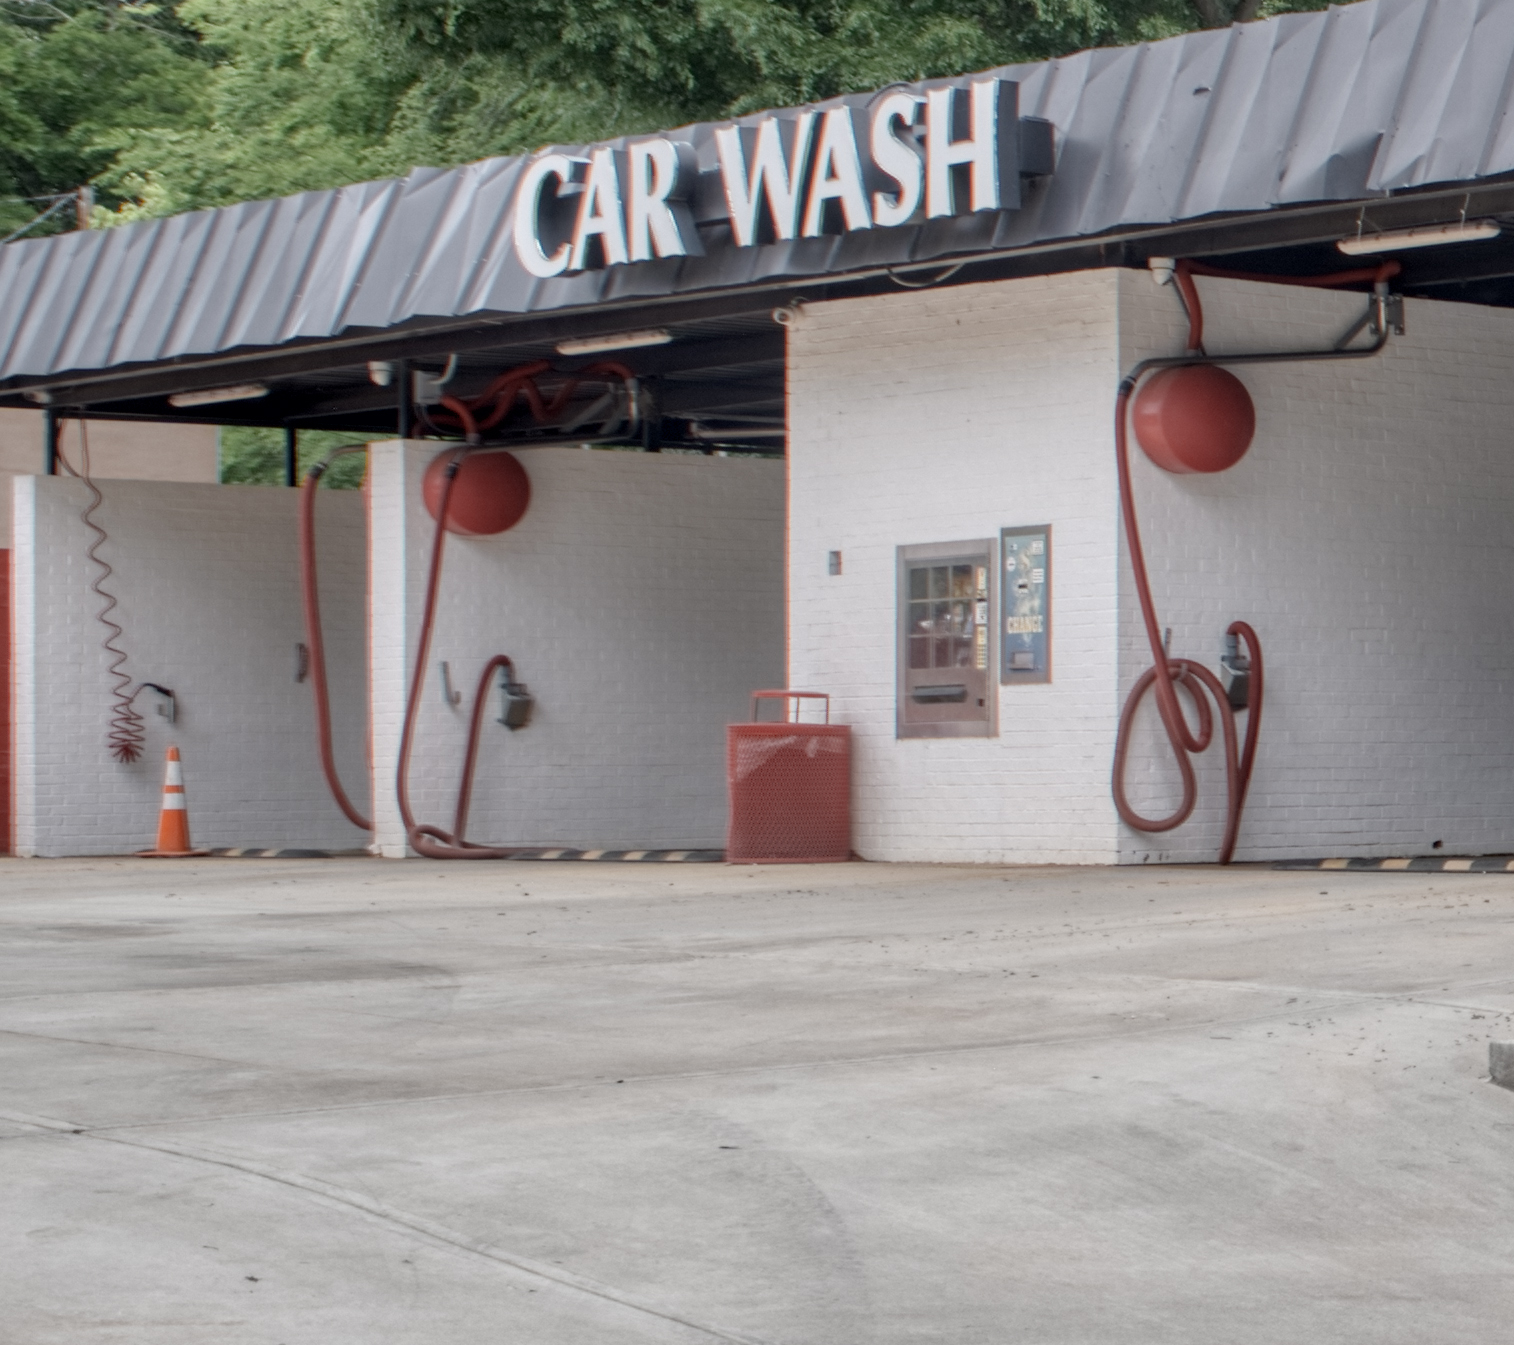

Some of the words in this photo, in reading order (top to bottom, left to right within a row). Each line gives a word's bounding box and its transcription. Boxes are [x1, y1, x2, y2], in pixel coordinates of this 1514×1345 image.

[514, 138, 687, 278] CAR
[715, 78, 1000, 247] WASH
[1007, 615, 1043, 634] CHANGE
